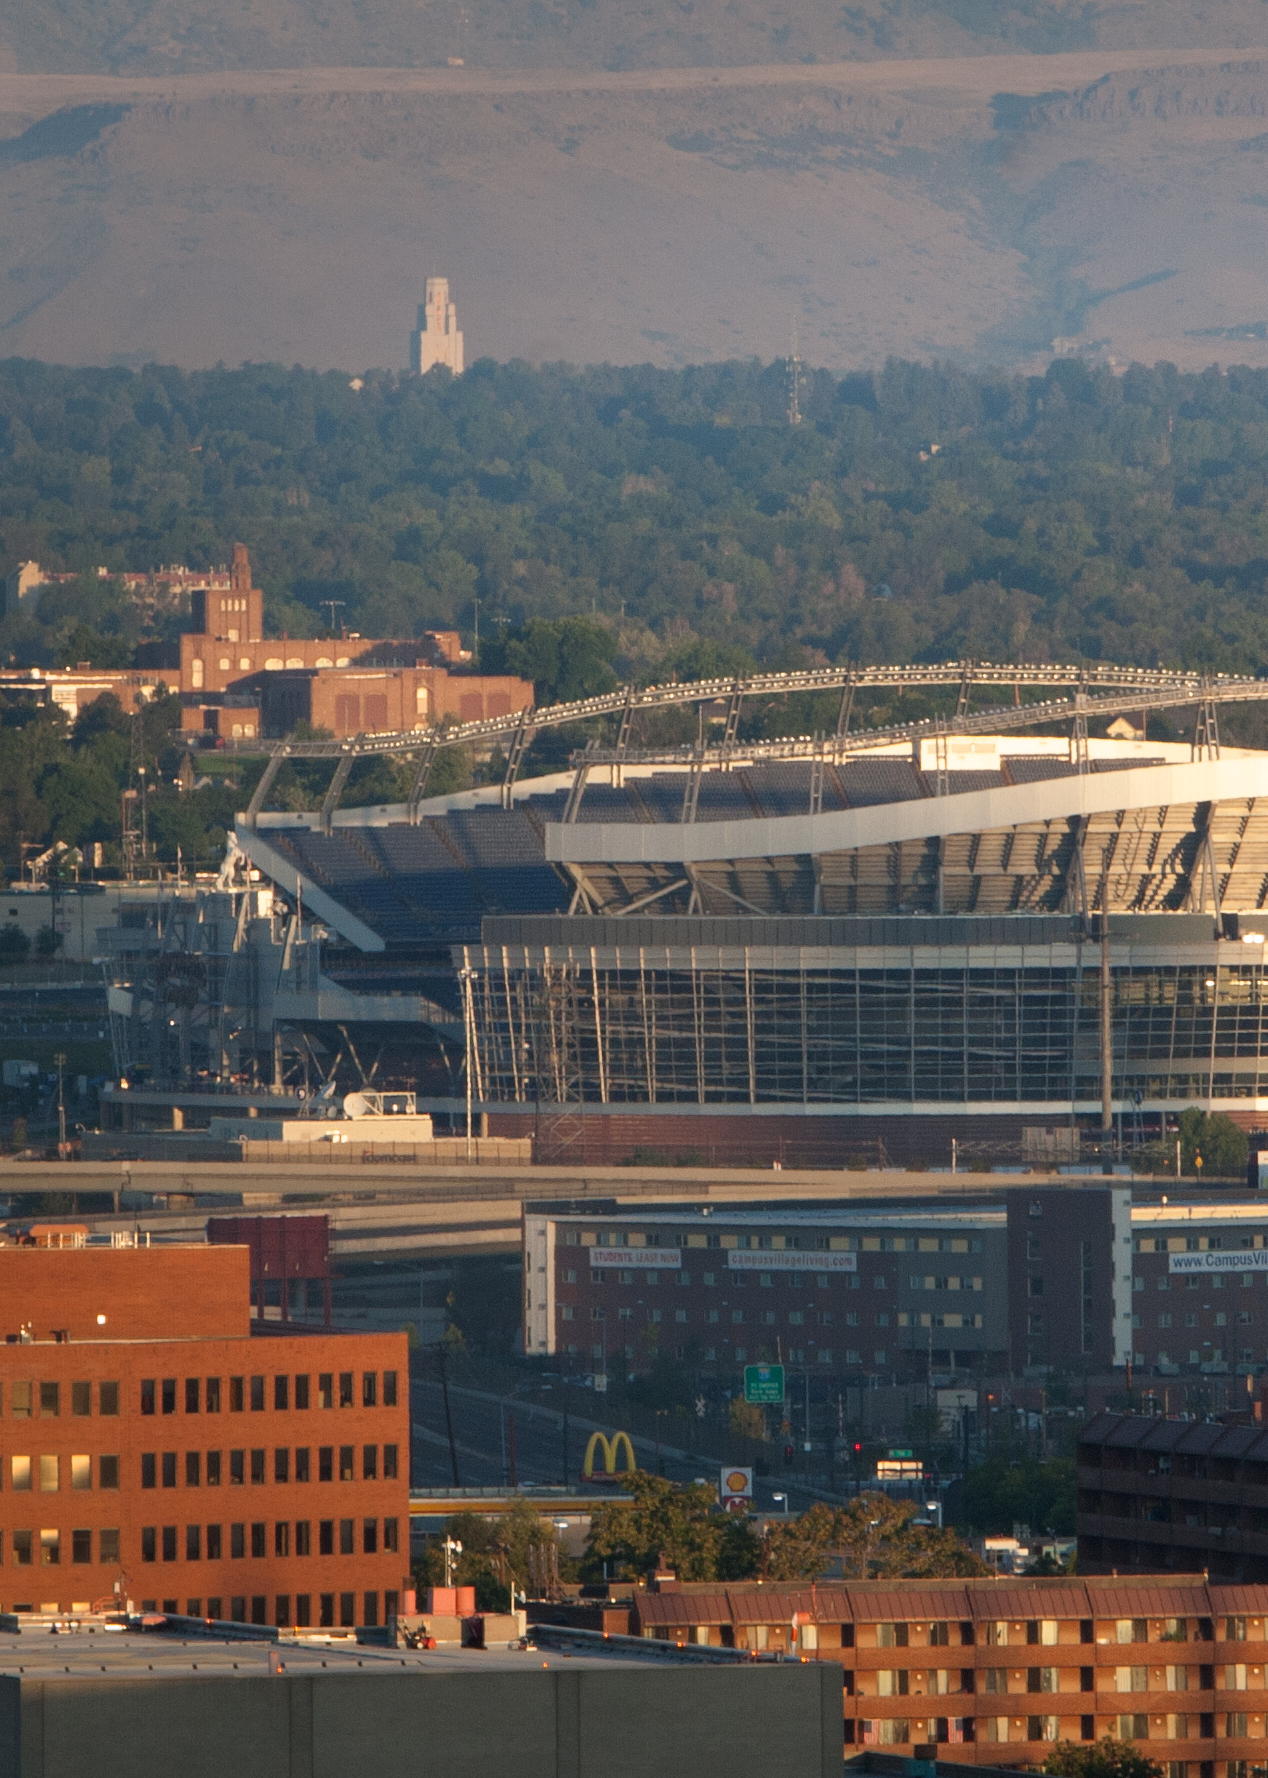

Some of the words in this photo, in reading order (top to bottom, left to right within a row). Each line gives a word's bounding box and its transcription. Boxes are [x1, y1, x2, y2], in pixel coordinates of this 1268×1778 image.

[635, 1252, 658, 1263] LEASE
[660, 1252, 680, 1264] NOW
[731, 1253, 854, 1269] campusvillageliving.com
